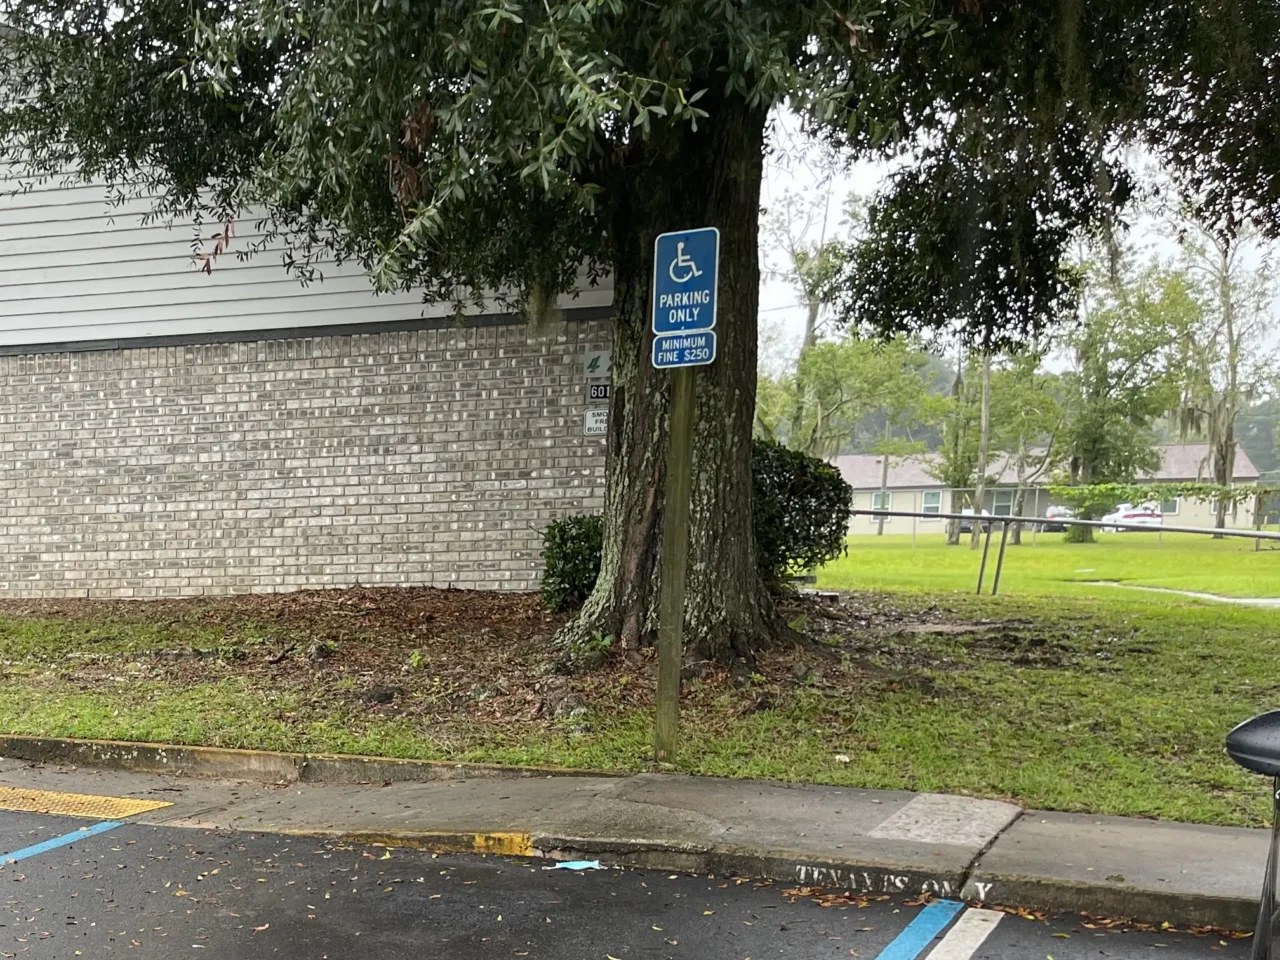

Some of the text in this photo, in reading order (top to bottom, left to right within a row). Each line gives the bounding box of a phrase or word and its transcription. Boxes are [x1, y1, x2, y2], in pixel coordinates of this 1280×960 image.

[660, 290, 710, 308] PARKING
[669, 307, 700, 323] ONLY
[662, 336, 706, 350] MINIMUM
[658, 348, 709, 363] FINE $250
